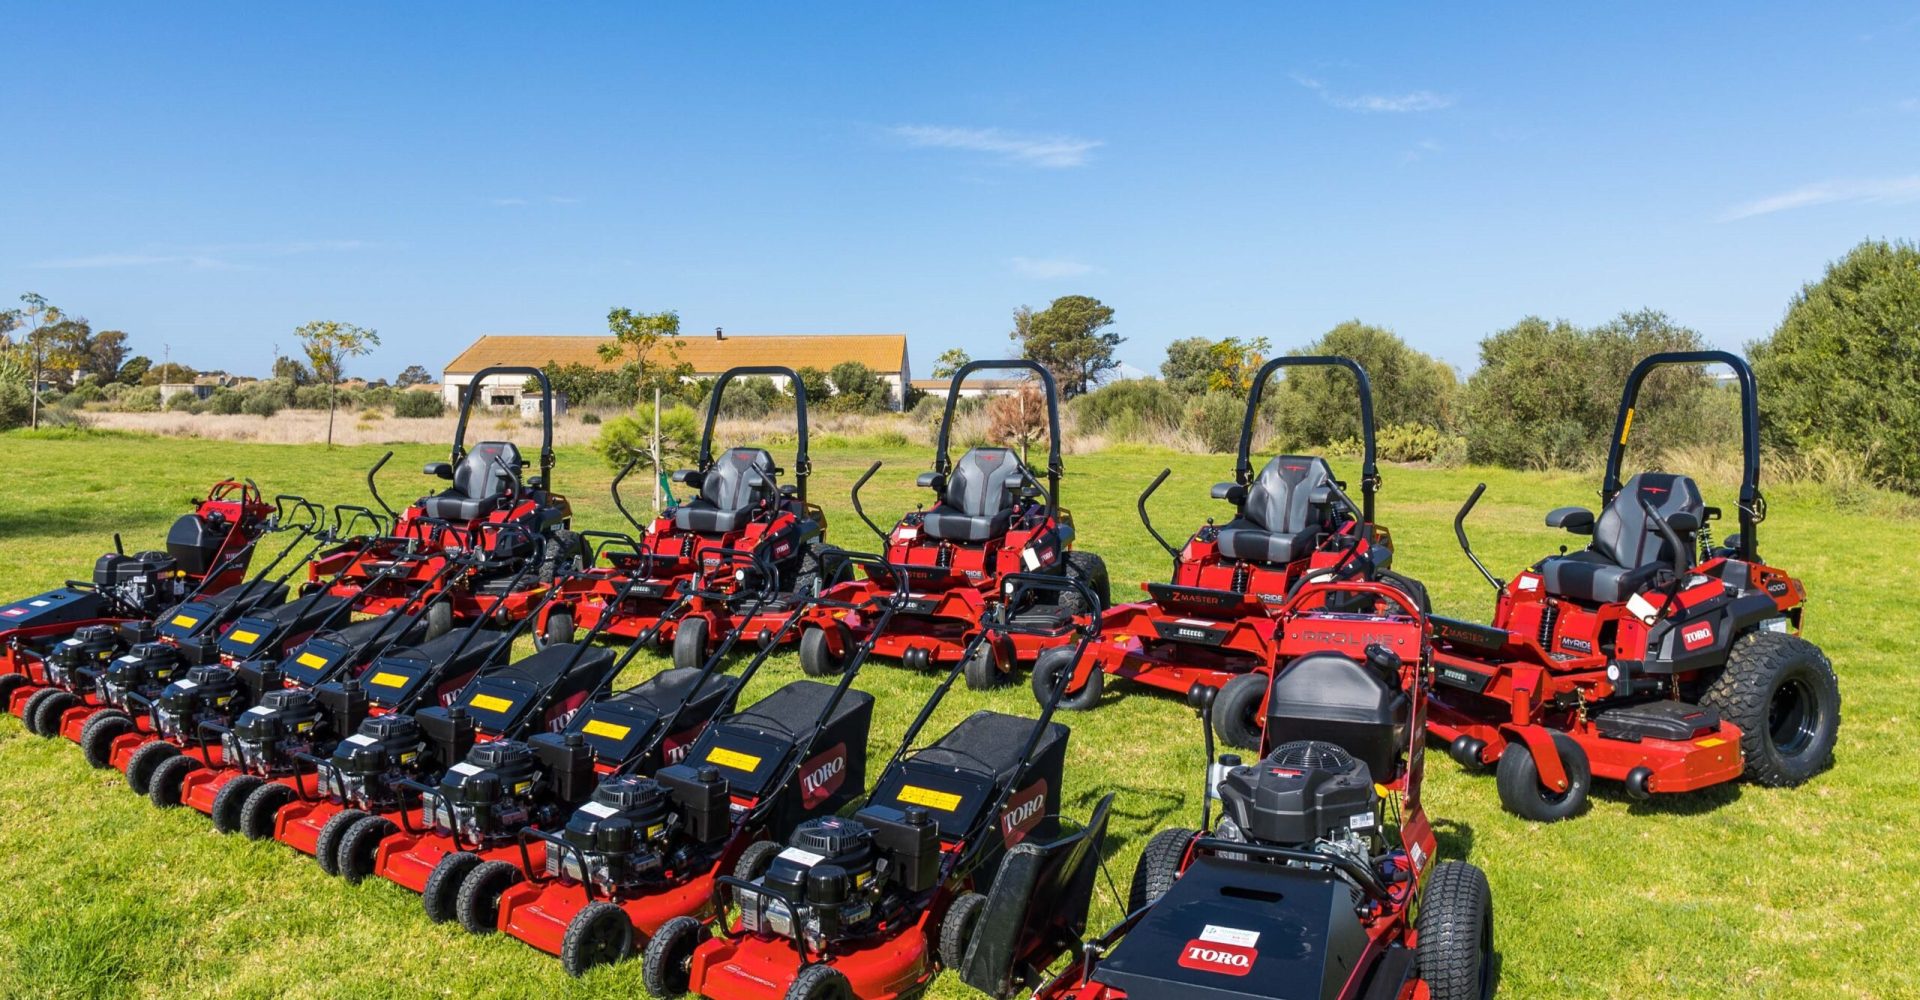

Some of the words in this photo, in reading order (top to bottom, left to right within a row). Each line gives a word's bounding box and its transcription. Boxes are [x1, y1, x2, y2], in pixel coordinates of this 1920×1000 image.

[1684, 628, 1712, 643] TORO
[803, 756, 845, 795] TORO
[1003, 794, 1044, 834] TORO
[1188, 947, 1250, 968] TORO
